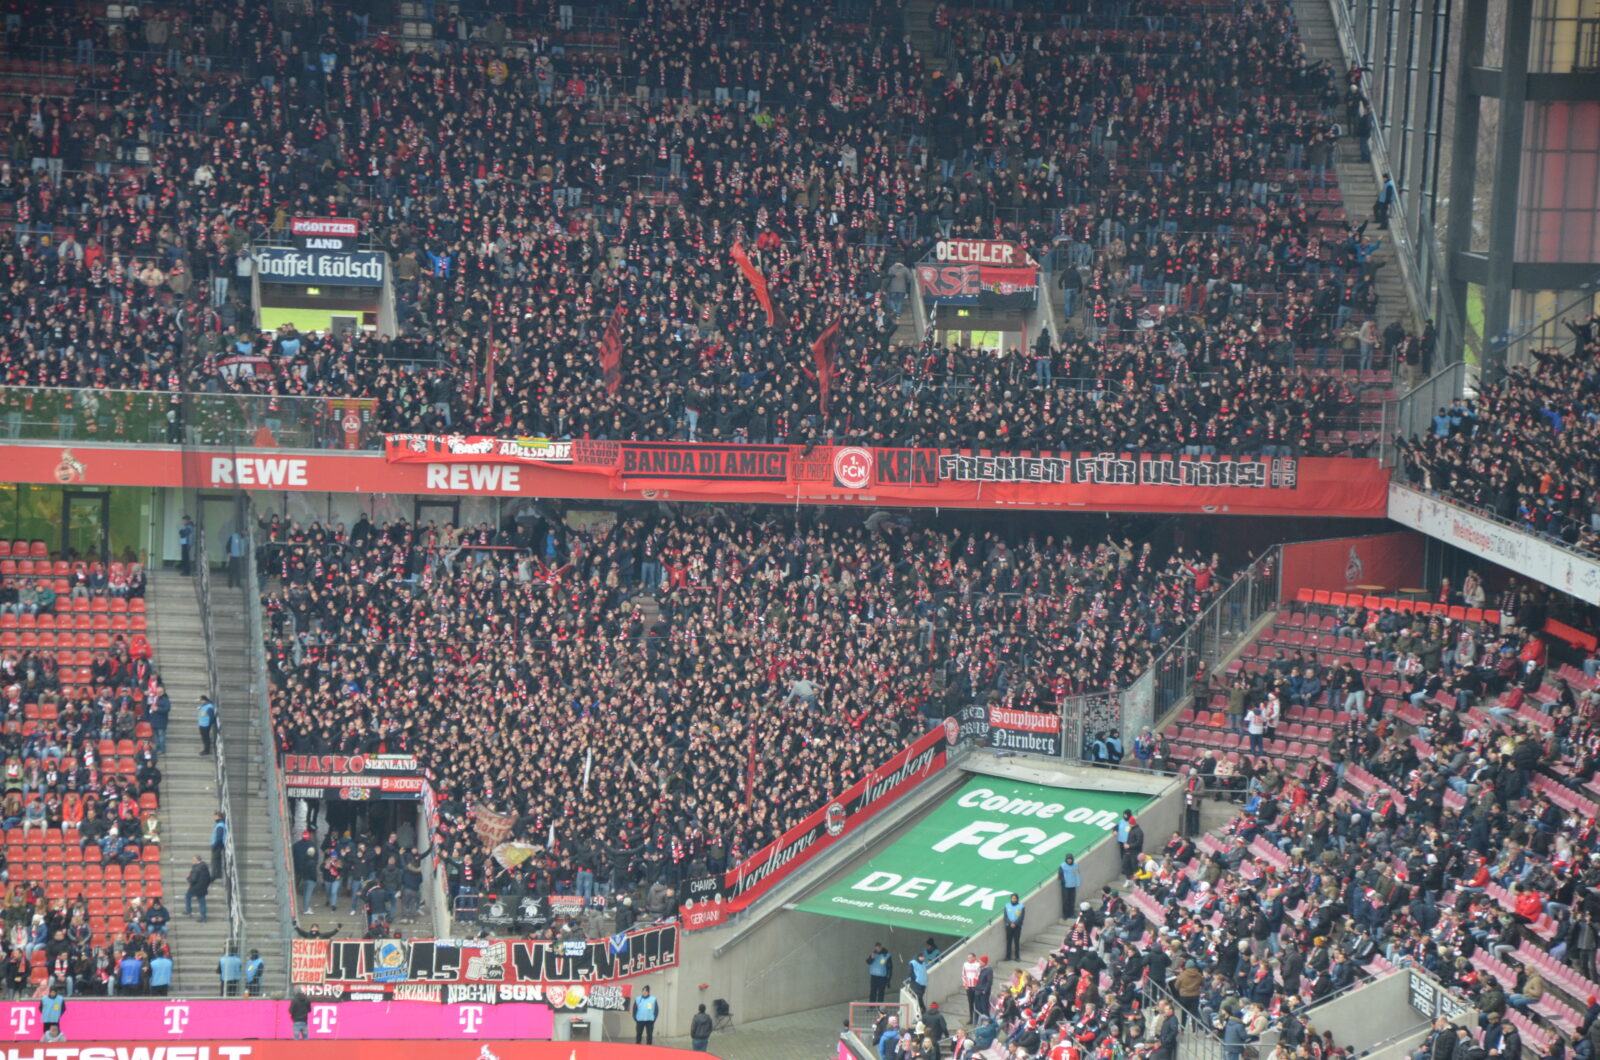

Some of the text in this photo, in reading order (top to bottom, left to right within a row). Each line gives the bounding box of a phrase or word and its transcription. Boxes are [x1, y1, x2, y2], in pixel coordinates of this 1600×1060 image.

[305, 238, 342, 249] LAND
[936, 241, 1013, 264] OECHLER
[258, 253, 382, 282] Gaffel Kölsch
[211, 457, 308, 486] REWE
[624, 451, 698, 473] BANDA
[725, 453, 786, 476] AMICI
[842, 465, 865, 478] FCN
[1075, 452, 1136, 485] FÜR
[426, 464, 521, 491] REWE
[992, 728, 1055, 755] Nürnberg
[285, 754, 364, 774] FIASKO
[365, 759, 418, 771] SEENLAND
[287, 788, 324, 798] NEUMARKT
[855, 748, 936, 814] Nürnberg
[957, 788, 1120, 831] Come on,
[931, 820, 1075, 865] FC!
[728, 828, 817, 903] Nordkurve
[690, 878, 717, 893] CHAMPS
[851, 871, 1013, 911] DEVK
[700, 895, 708, 907] OF
[831, 895, 974, 924] Gesagt. Getan. Geholfen.
[500, 984, 543, 1001] SGN
[0, 1045, 251, 1060] HTSWELT
